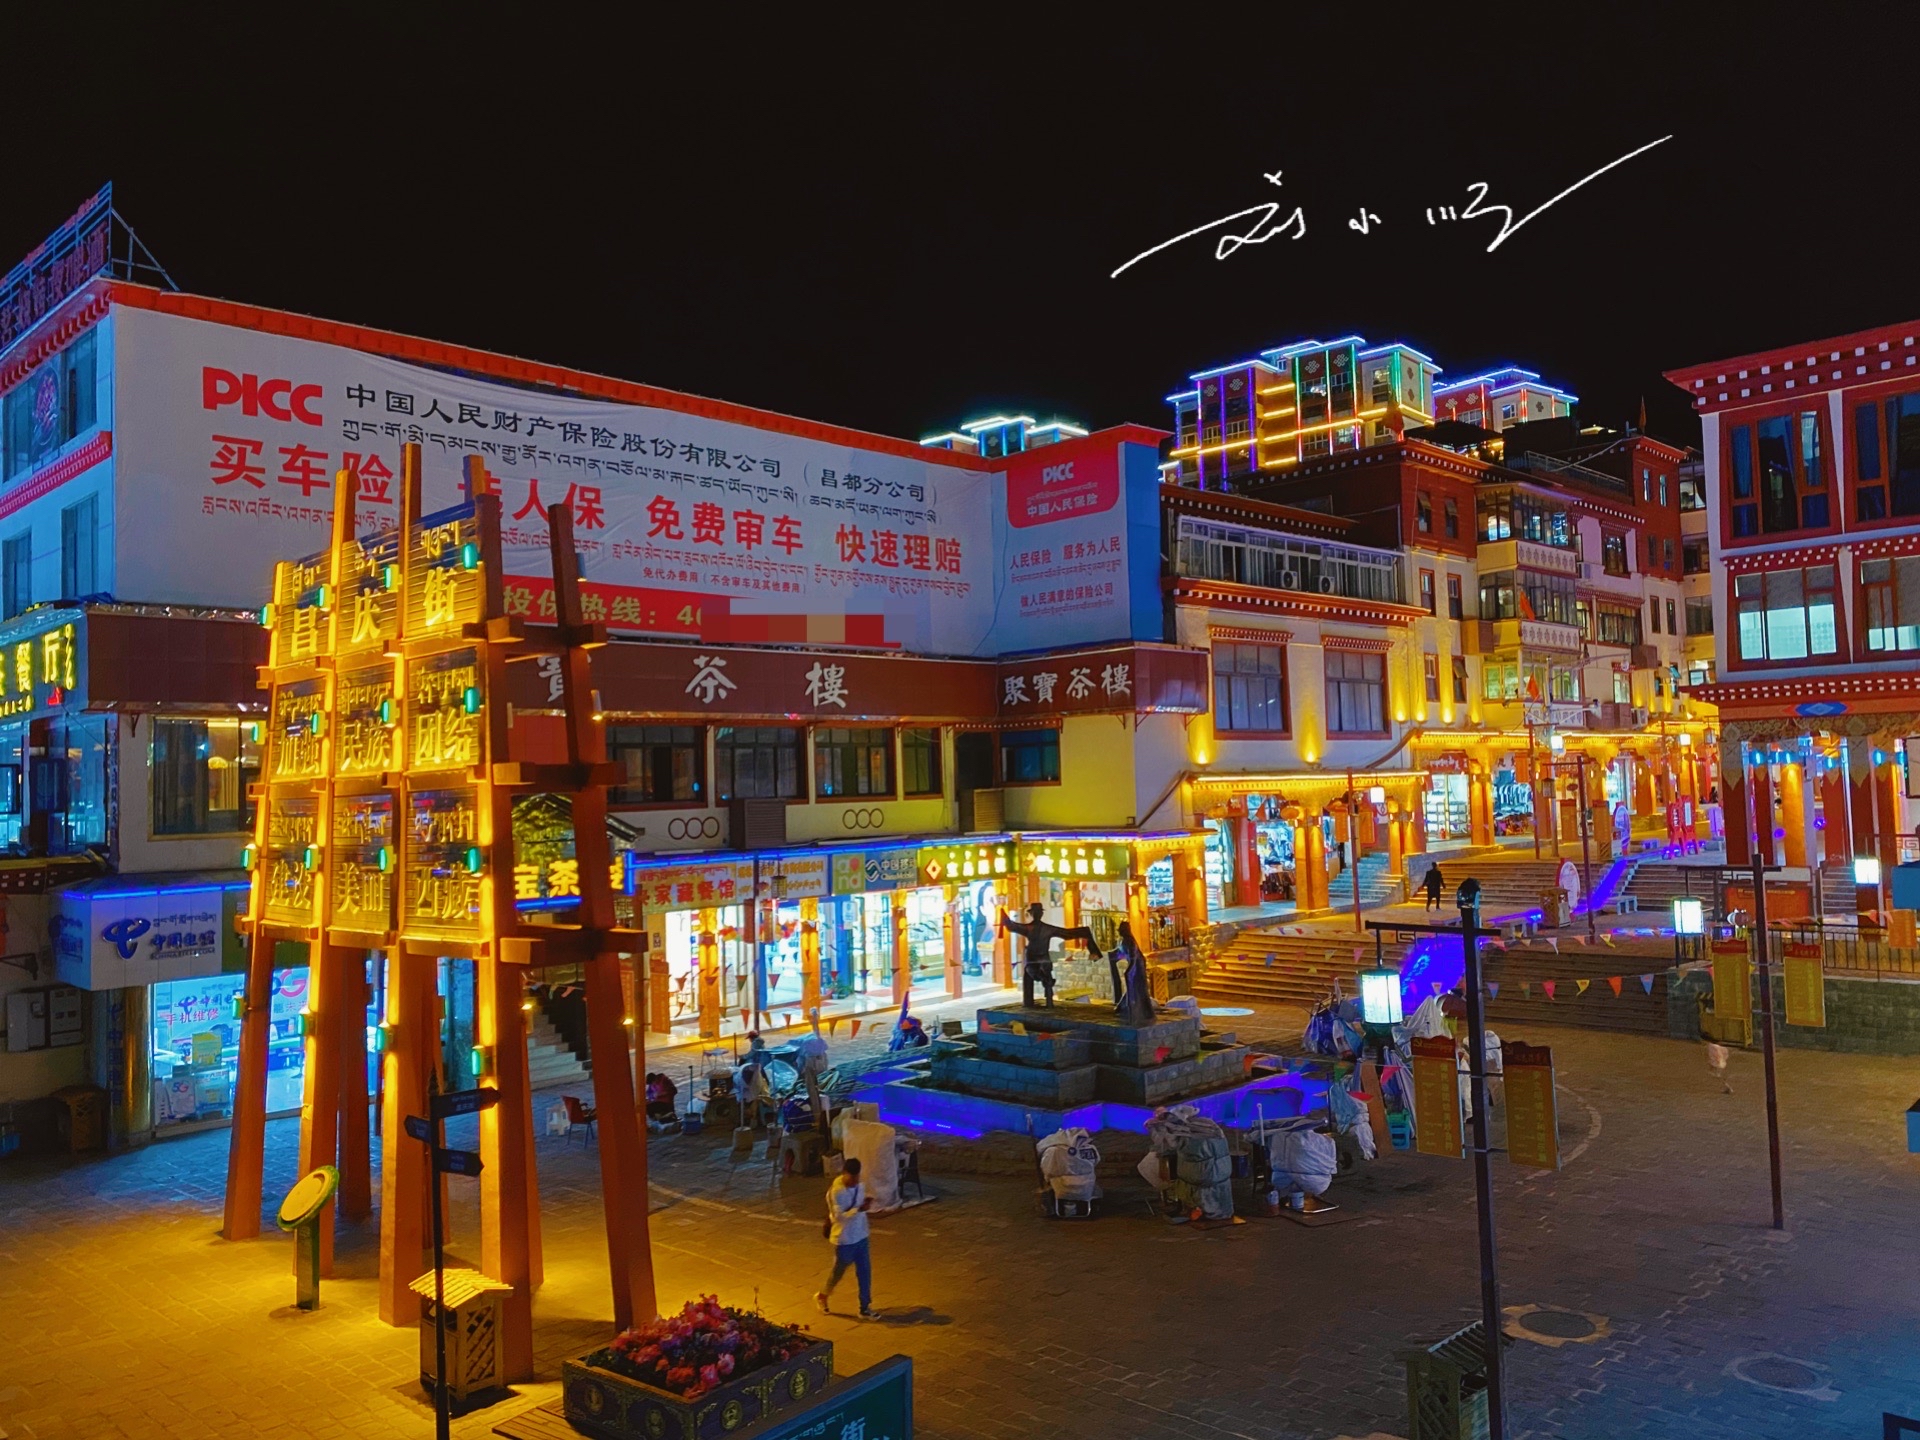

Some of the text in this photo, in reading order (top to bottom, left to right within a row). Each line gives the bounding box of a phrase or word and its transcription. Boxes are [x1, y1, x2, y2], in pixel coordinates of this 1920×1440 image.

[202, 366, 323, 426] PICC
[346, 383, 781, 478] 中国人民财产保险股份有限公司
[1042, 462, 1074, 485] PICC
[210, 434, 394, 505] 买车险
[646, 495, 803, 555] 免费审车
[835, 524, 962, 574] 快速理赔
[1027, 493, 1099, 518] 中国人民保险
[1009, 549, 1052, 569] 人民保险
[1003, 664, 1133, 705] 聚寶茶樓
[200, 993, 233, 1007] 中国电
[167, 1008, 219, 1025] 手机维修
